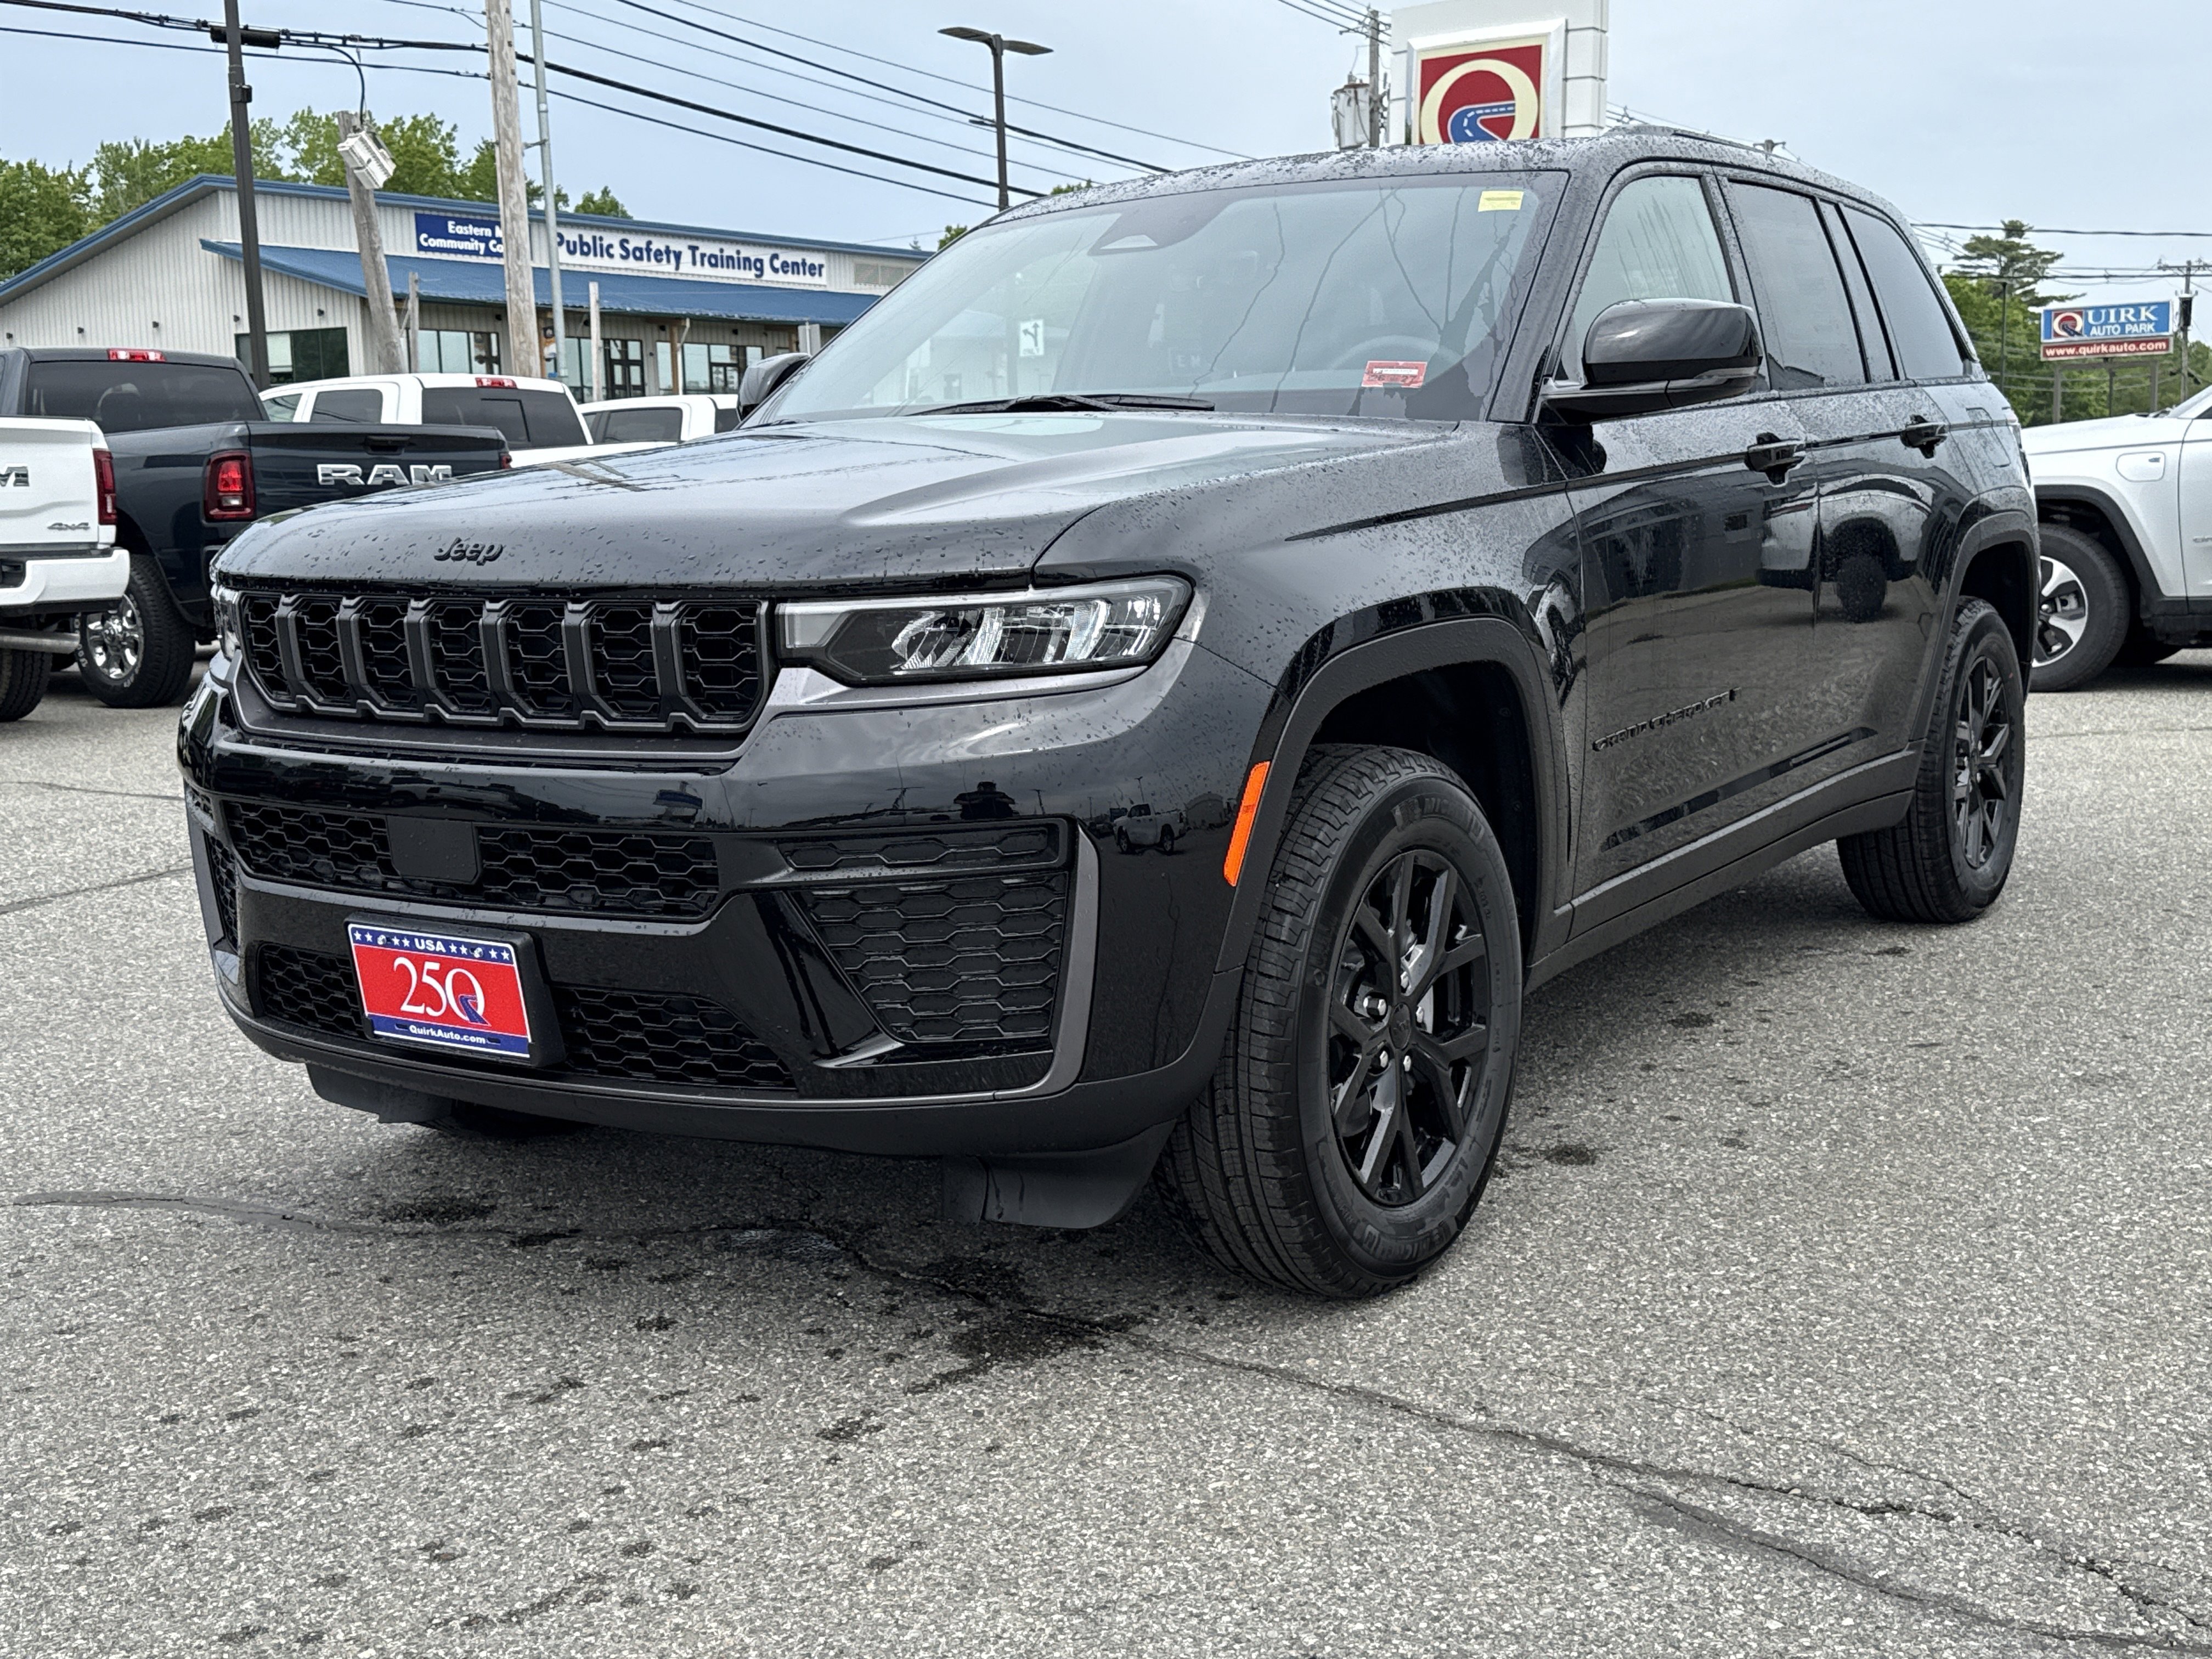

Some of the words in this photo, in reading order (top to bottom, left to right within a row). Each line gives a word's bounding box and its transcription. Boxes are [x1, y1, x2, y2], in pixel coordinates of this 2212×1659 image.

[447, 221, 492, 237] Eastern
[419, 233, 486, 255] Community
[556, 232, 614, 259] Public
[618, 238, 682, 271] Safety
[688, 245, 764, 278] Training
[769, 253, 825, 278] Center
[2053, 305, 2159, 337] QUIRK
[2090, 324, 2120, 336] AUTO
[2125, 323, 2155, 334] PARK
[2045, 341, 2166, 356] www.quirkauto.com
[317, 464, 453, 485] RAM
[434, 537, 504, 566] Jeep
[414, 938, 447, 953] USA
[409, 1024, 486, 1044] QuirkAuto.com
